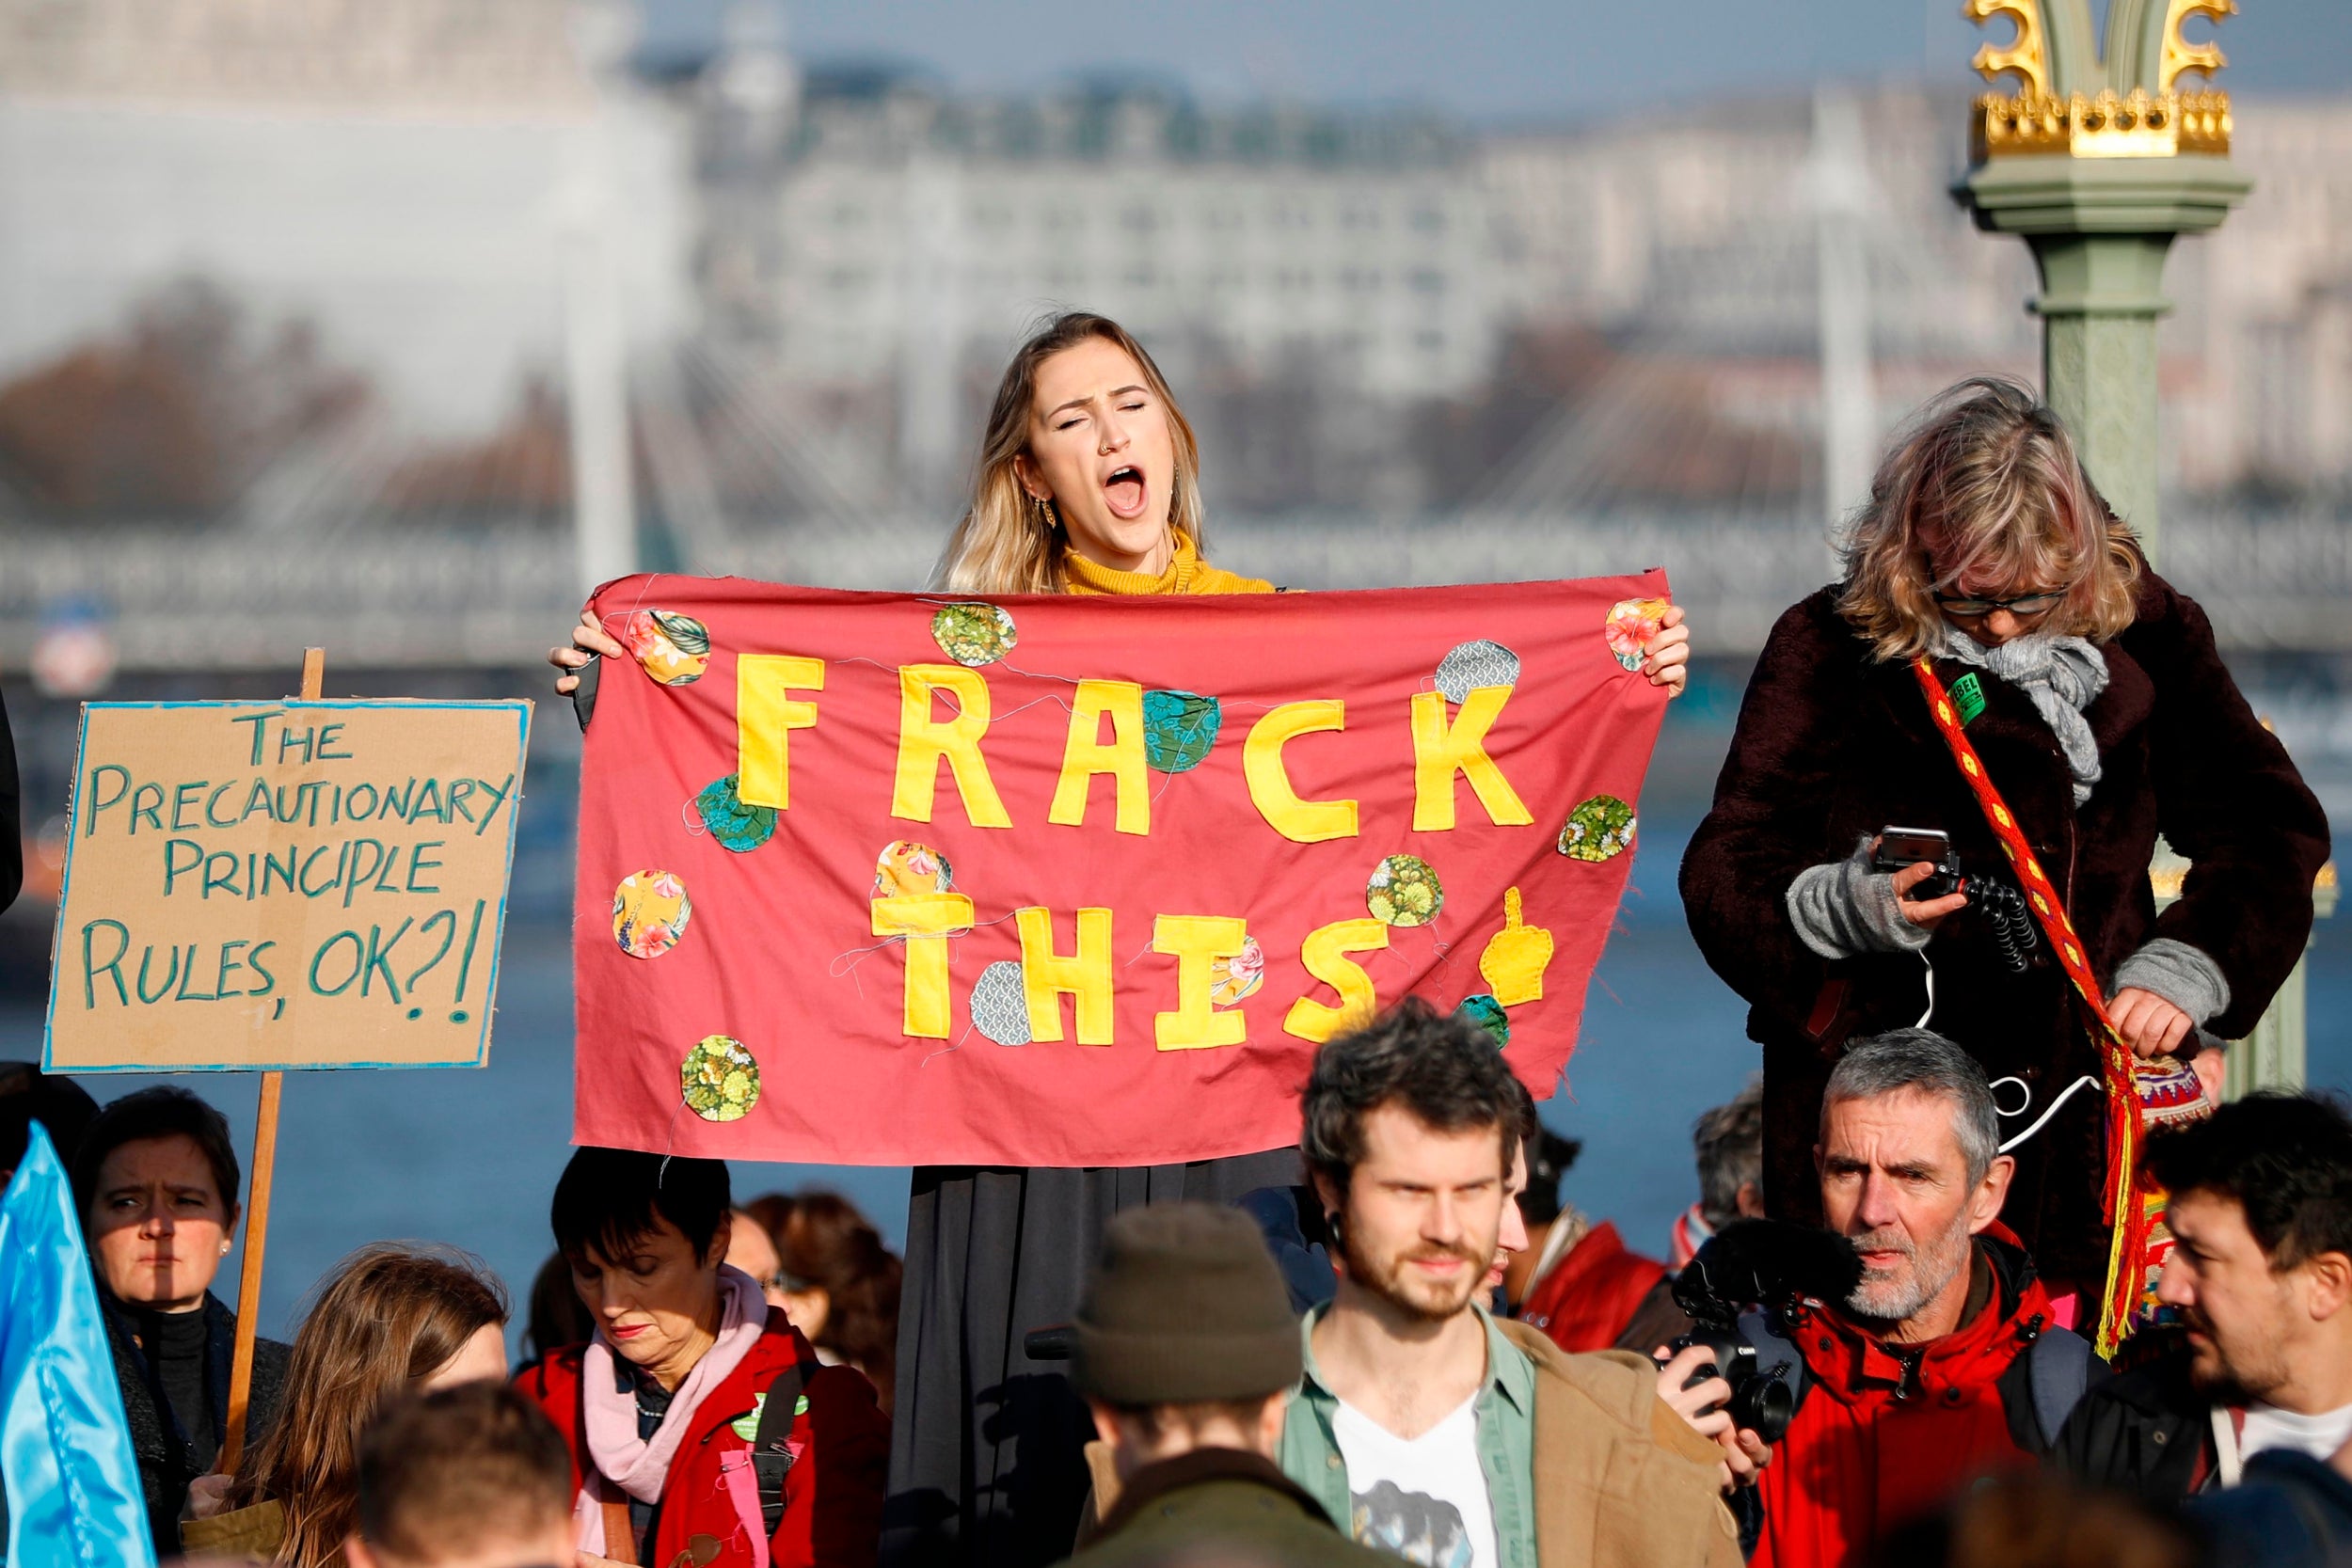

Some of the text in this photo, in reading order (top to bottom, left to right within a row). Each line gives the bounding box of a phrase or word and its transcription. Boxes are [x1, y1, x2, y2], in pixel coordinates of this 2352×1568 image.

[1953, 677, 1978, 702] EBEL
[231, 709, 354, 766] THE
[736, 653, 1534, 844] FRACK
[85, 764, 515, 838] PRECAUTIONARY
[163, 838, 445, 909] PRINCIPLE
[82, 898, 486, 1024] RULES, OK?!
[870, 892, 1390, 1051] THIS
